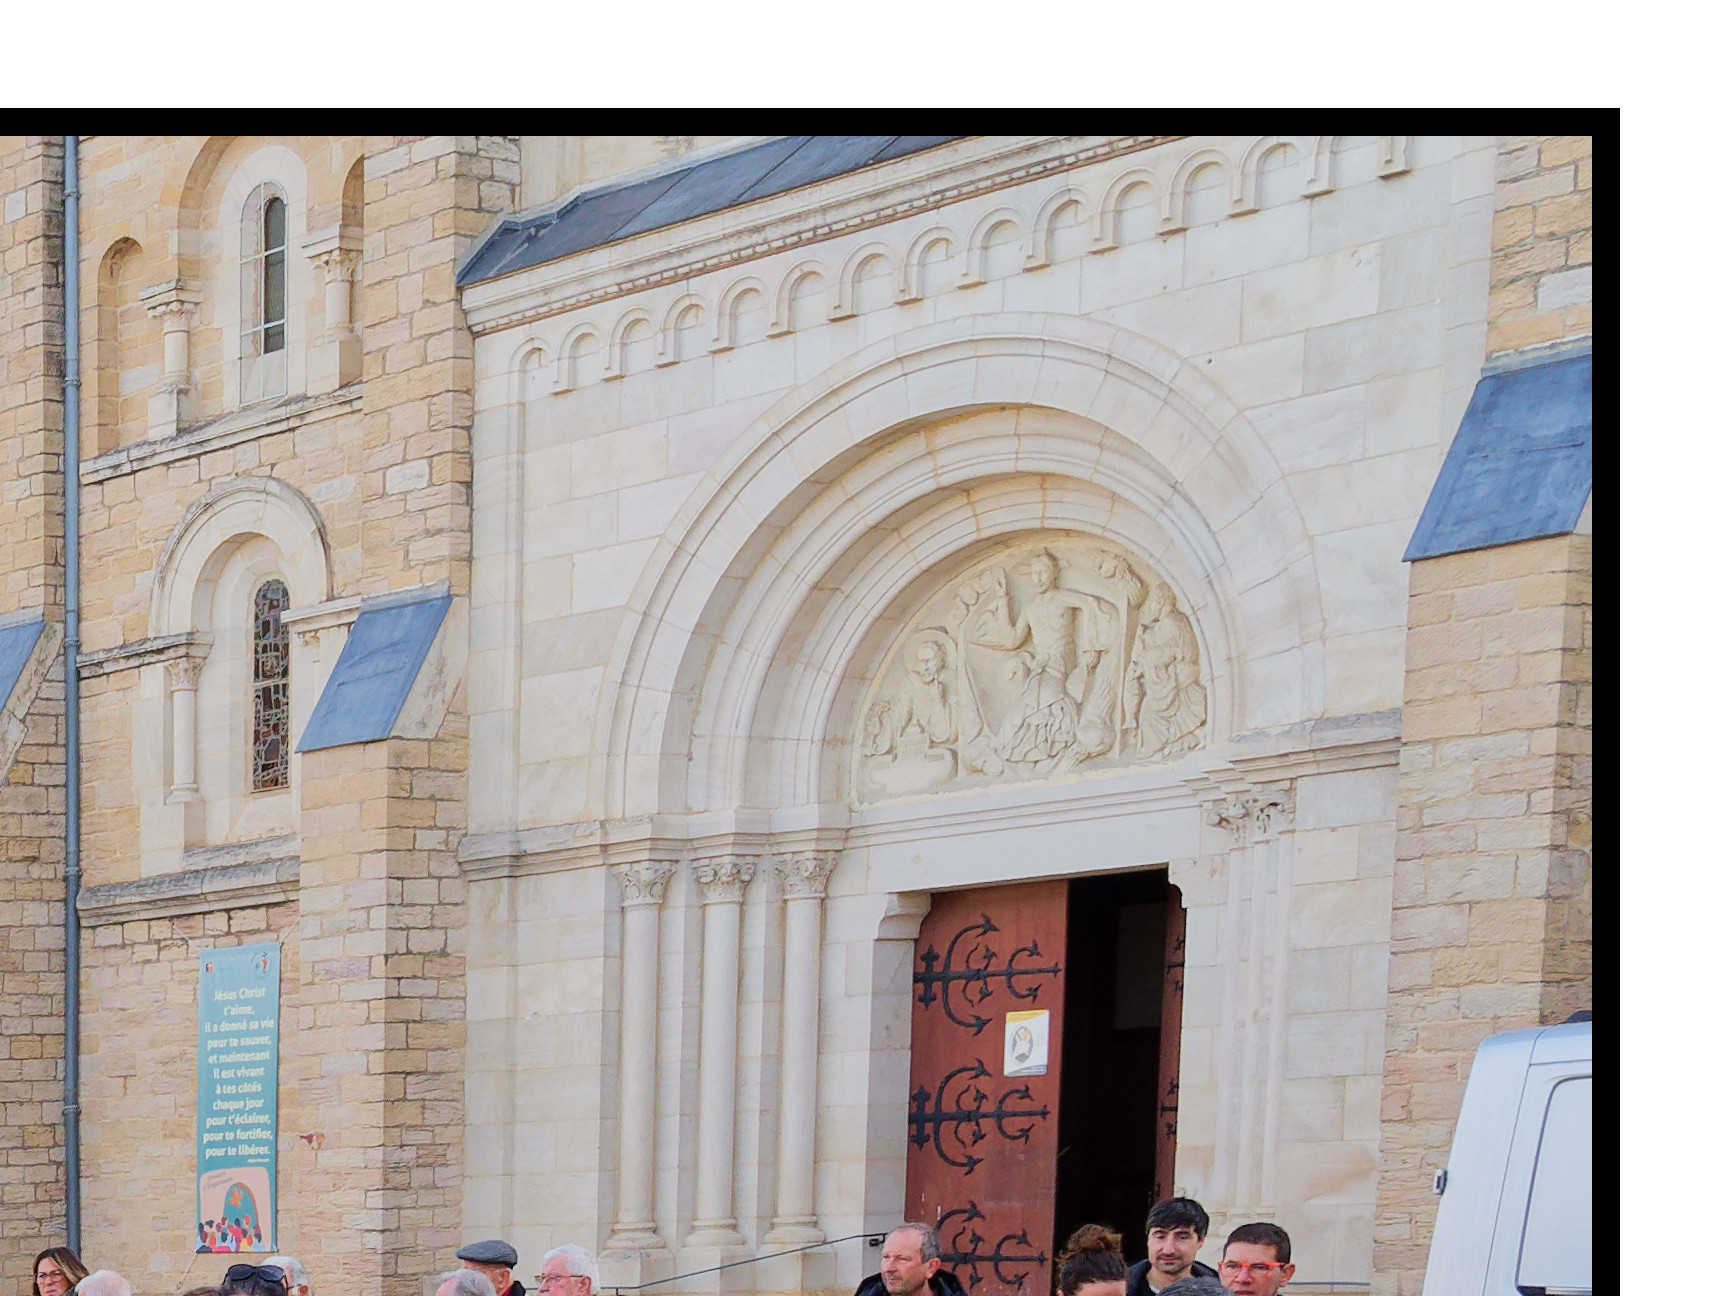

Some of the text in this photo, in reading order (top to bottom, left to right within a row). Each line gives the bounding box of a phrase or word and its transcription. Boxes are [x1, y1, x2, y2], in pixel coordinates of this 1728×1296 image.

[214, 986, 266, 1002] Jésus Christ
[224, 1003, 255, 1016] t'aime,
[219, 1019, 247, 1032] donné
[249, 1020, 259, 1030] sa
[260, 1015, 275, 1029] vie
[207, 1039, 228, 1051] pour
[229, 1037, 239, 1047] te
[208, 1050, 270, 1064] et maintenant
[221, 1068, 235, 1079] est
[236, 1066, 265, 1078] vivant
[222, 1083, 237, 1094] tes
[237, 1081, 262, 1093] côtés
[212, 1096, 265, 1112] chaque jour
[206, 1117, 227, 1129] pour
[203, 1132, 224, 1144] pour
[225, 1131, 235, 1141] te
[205, 1147, 226, 1160] pour
[227, 1146, 237, 1156] te
